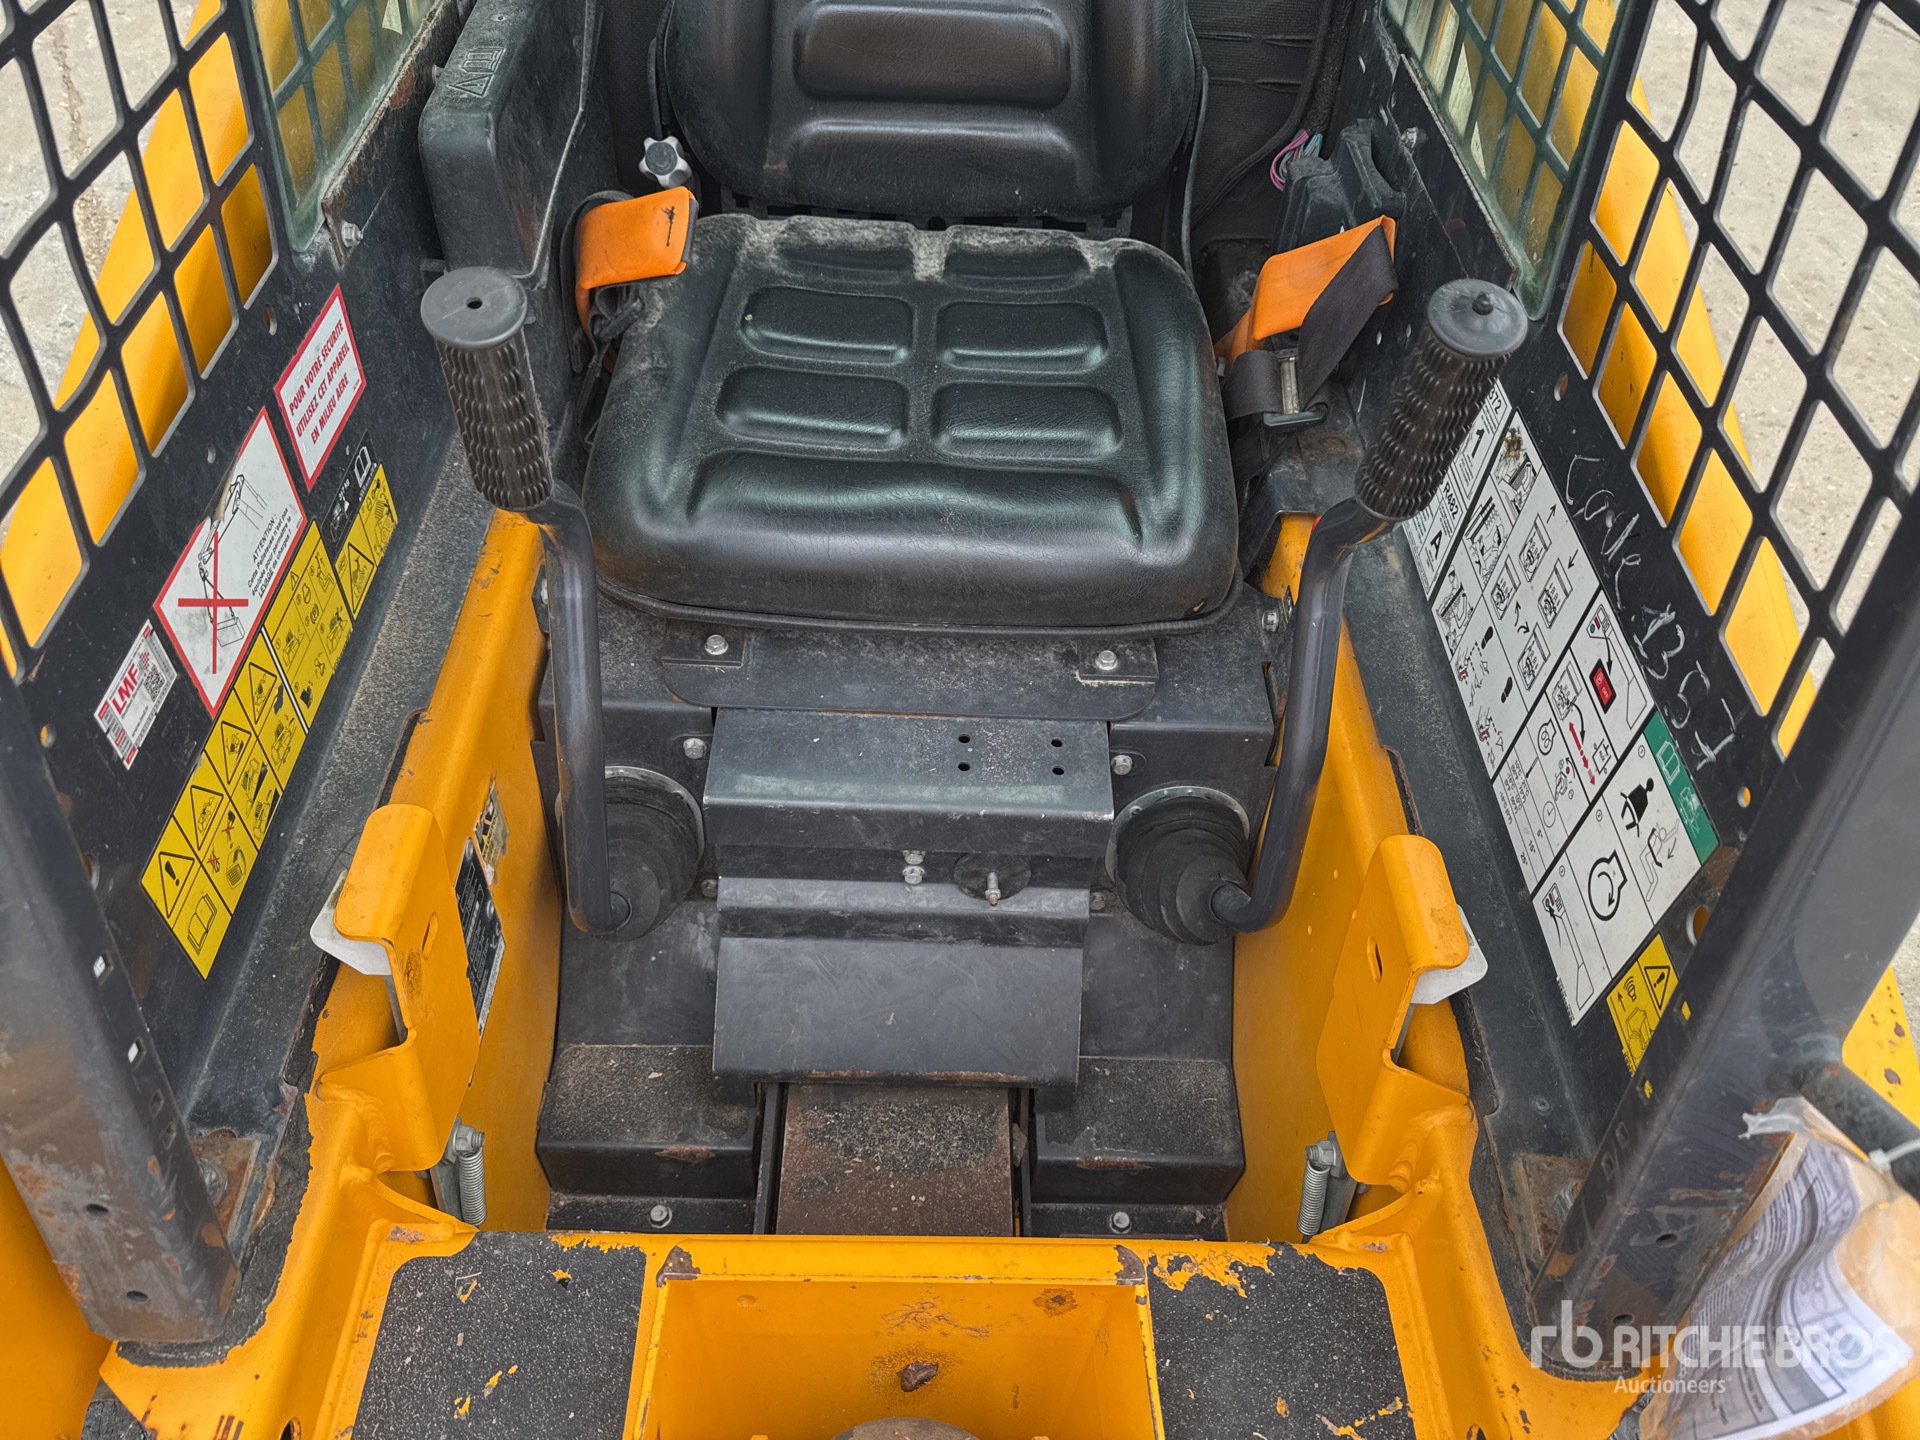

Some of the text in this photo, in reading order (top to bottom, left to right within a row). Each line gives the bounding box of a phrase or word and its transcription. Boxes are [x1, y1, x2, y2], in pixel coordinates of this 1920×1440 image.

[288, 319, 344, 416] POUR VOTRE SECURITE
[296, 341, 350, 438] UTILISEZ CET APPAREIL
[310, 373, 349, 445] EN MILIEU AERE
[1472, 428, 1485, 459] 1
[1443, 481, 1459, 521] R482
[247, 569, 258, 588] Cette
[256, 535, 275, 570] Pelleteuse
[252, 517, 275, 562] ATTENTION
[264, 552, 273, 570] pour
[272, 522, 288, 555] permettre
[1430, 529, 1443, 560] A
[258, 567, 274, 599] LEVAGE
[276, 535, 290, 560] charges
[111, 663, 139, 715] LMF
